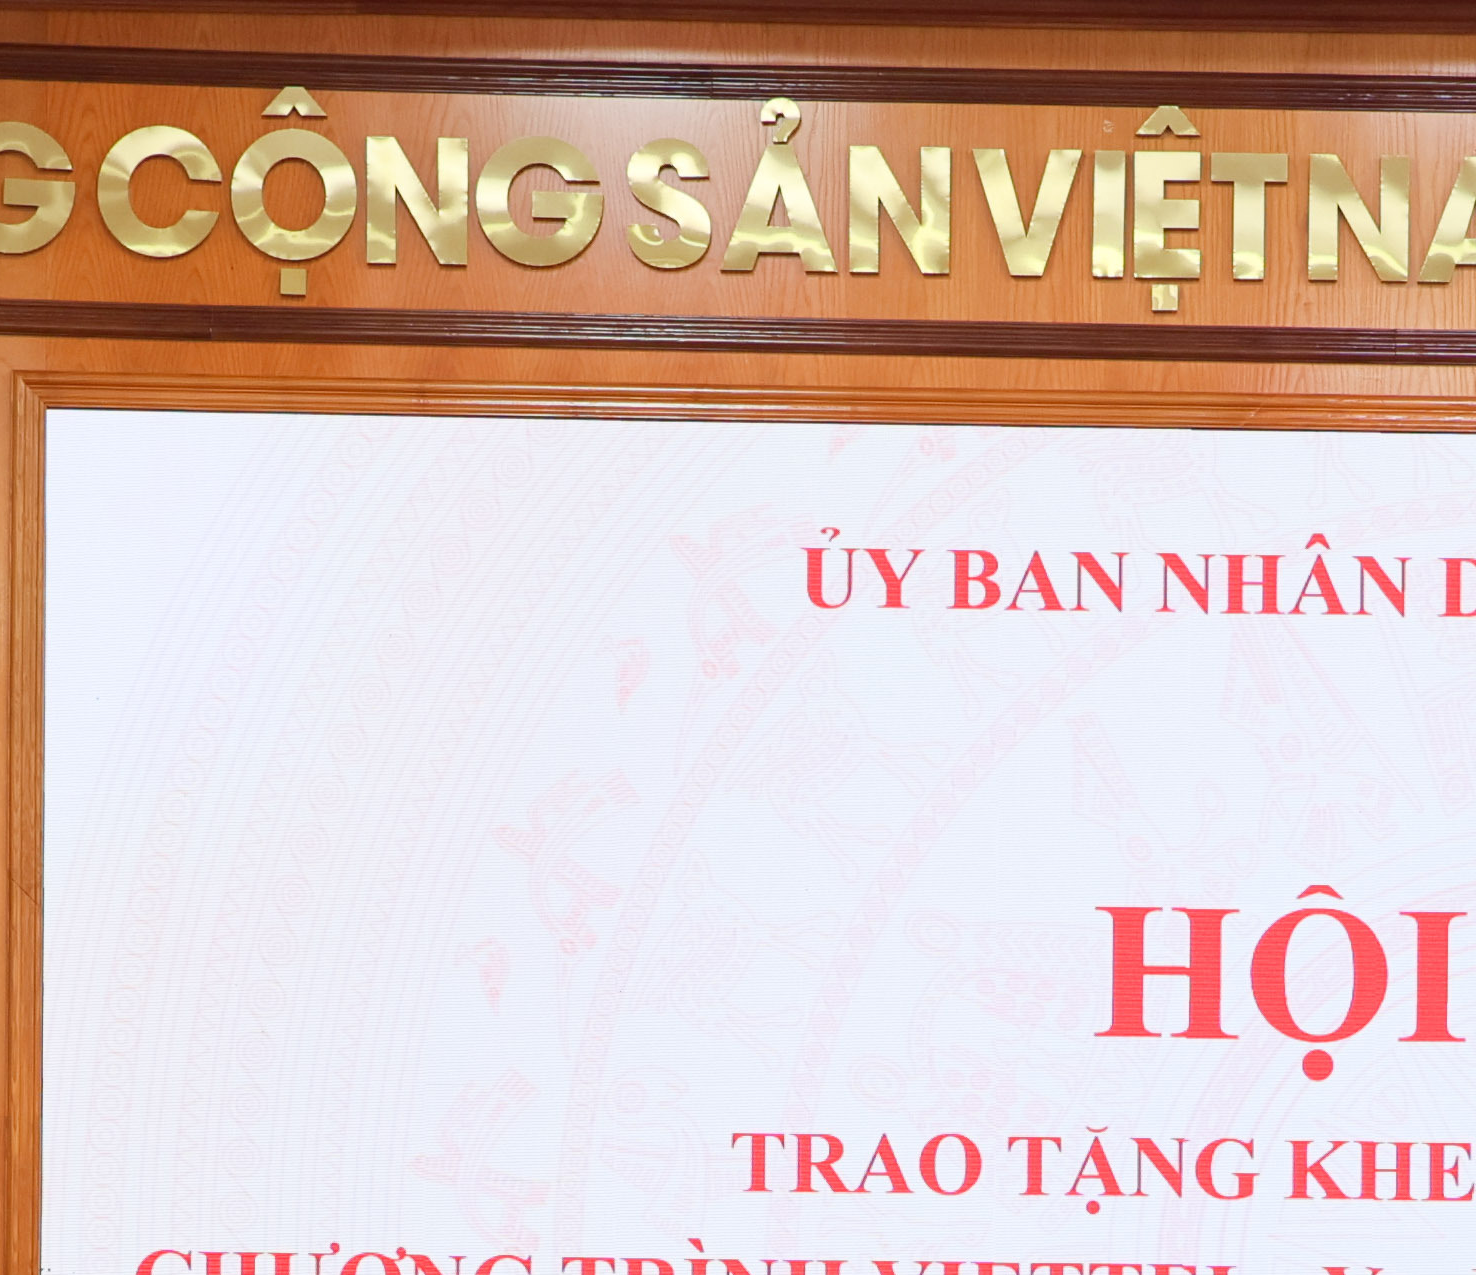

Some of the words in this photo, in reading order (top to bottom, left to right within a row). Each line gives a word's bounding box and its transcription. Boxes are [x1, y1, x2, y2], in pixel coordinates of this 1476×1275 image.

[96, 86, 605, 297] CỘNG
[627, 98, 952, 276] SẢN
[973, 106, 1289, 312] VIỆT
[804, 526, 924, 611] ỦY
[951, 549, 1128, 612] BAN
[1157, 532, 1410, 616] NHÂN
[1095, 883, 1468, 1082] HỘI
[731, 1131, 984, 1197] TRAO
[1007, 1121, 1258, 1216] TẶNG
